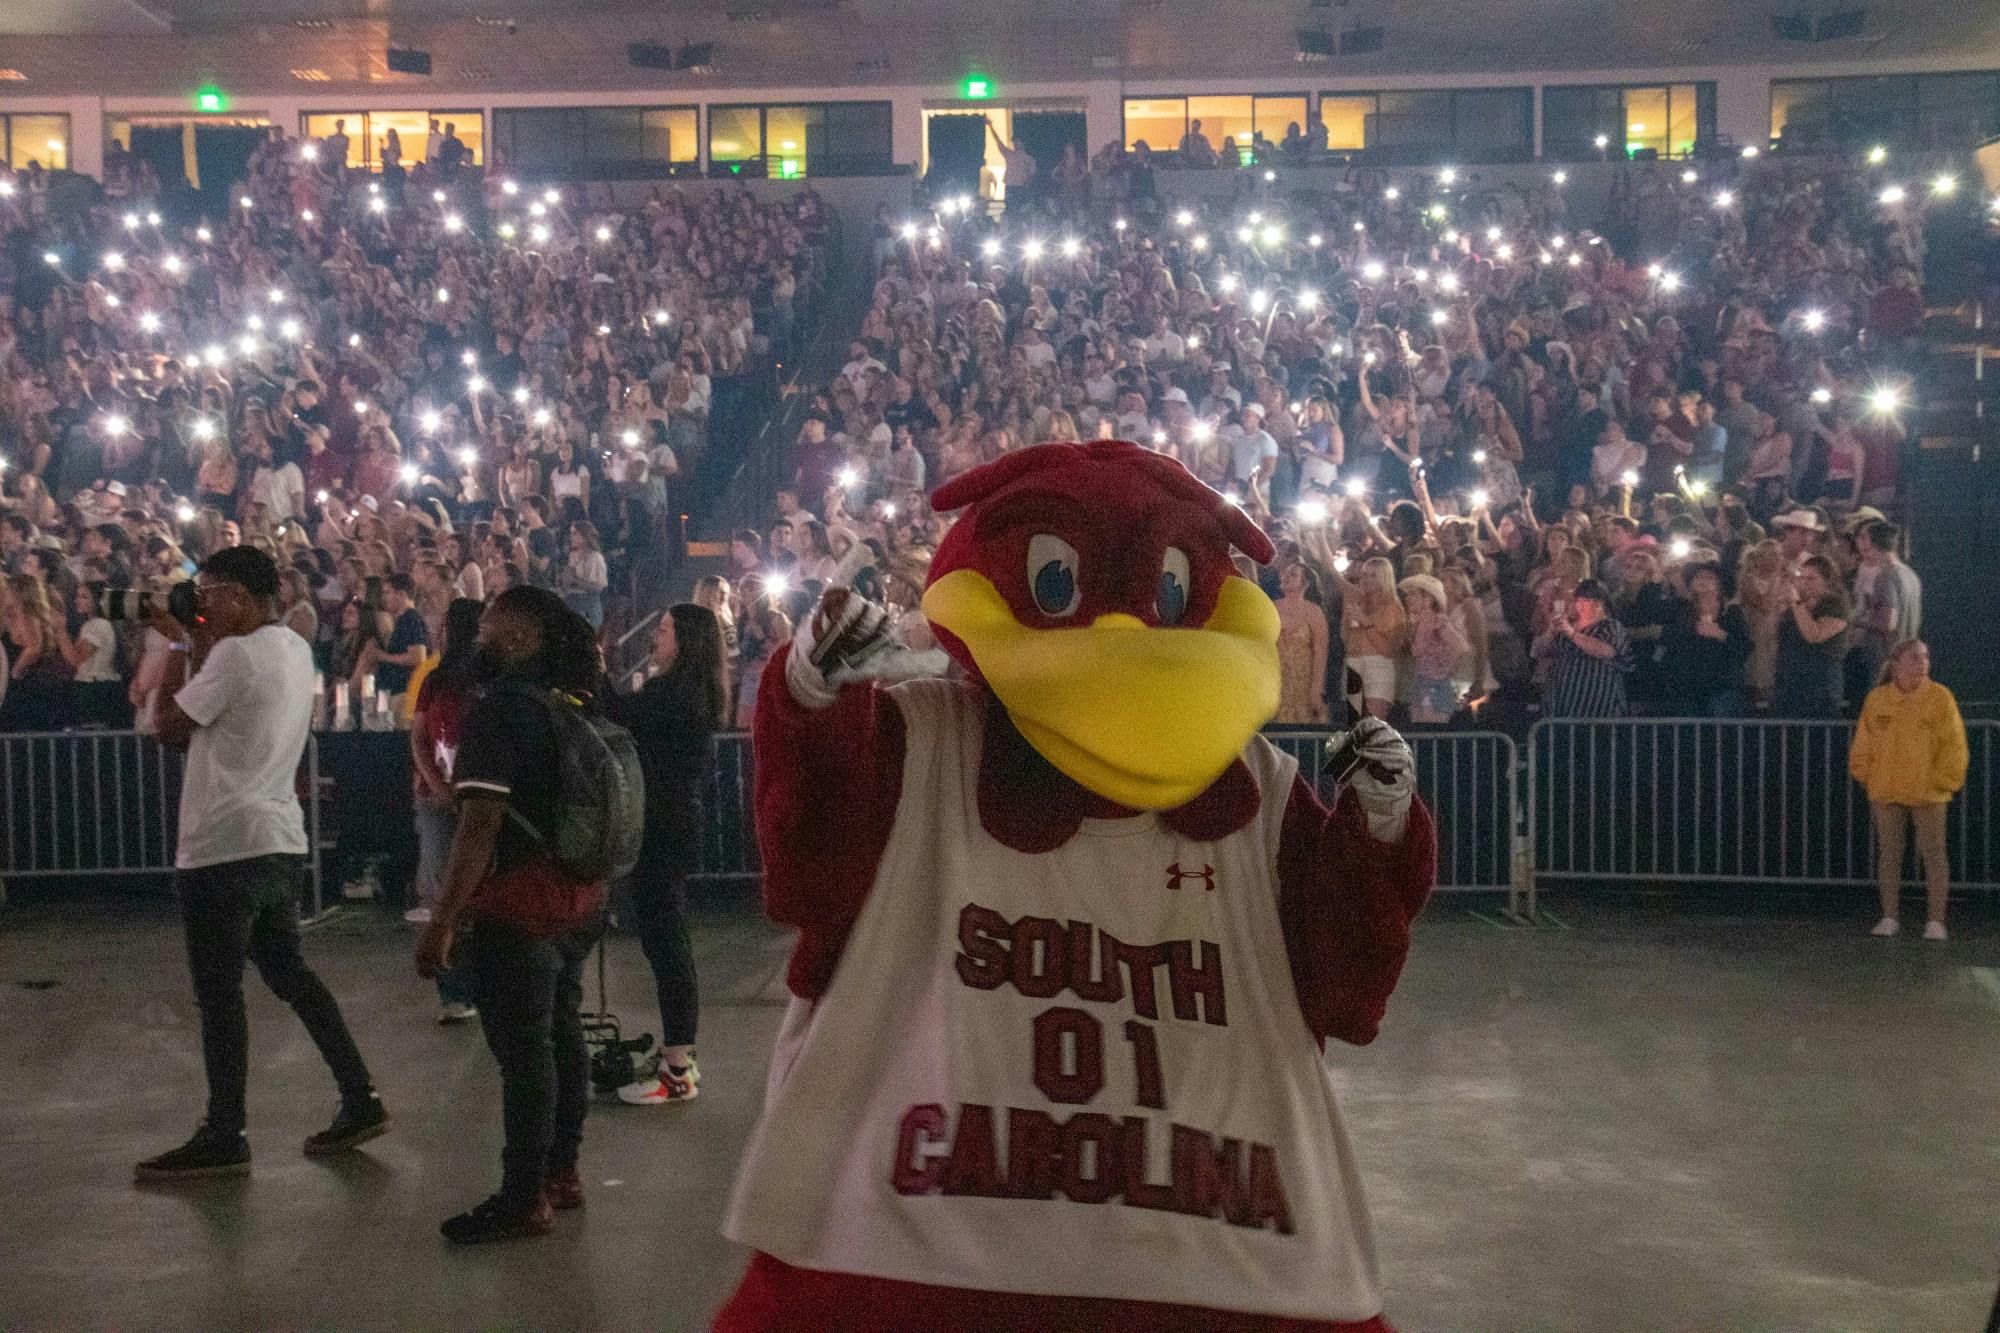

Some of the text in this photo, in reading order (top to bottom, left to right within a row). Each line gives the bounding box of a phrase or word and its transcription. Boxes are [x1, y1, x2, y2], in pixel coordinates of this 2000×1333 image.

[956, 903, 1228, 1026] SOUTH
[1034, 1006, 1166, 1110] 01
[893, 1103, 1295, 1235] CAROLINA
